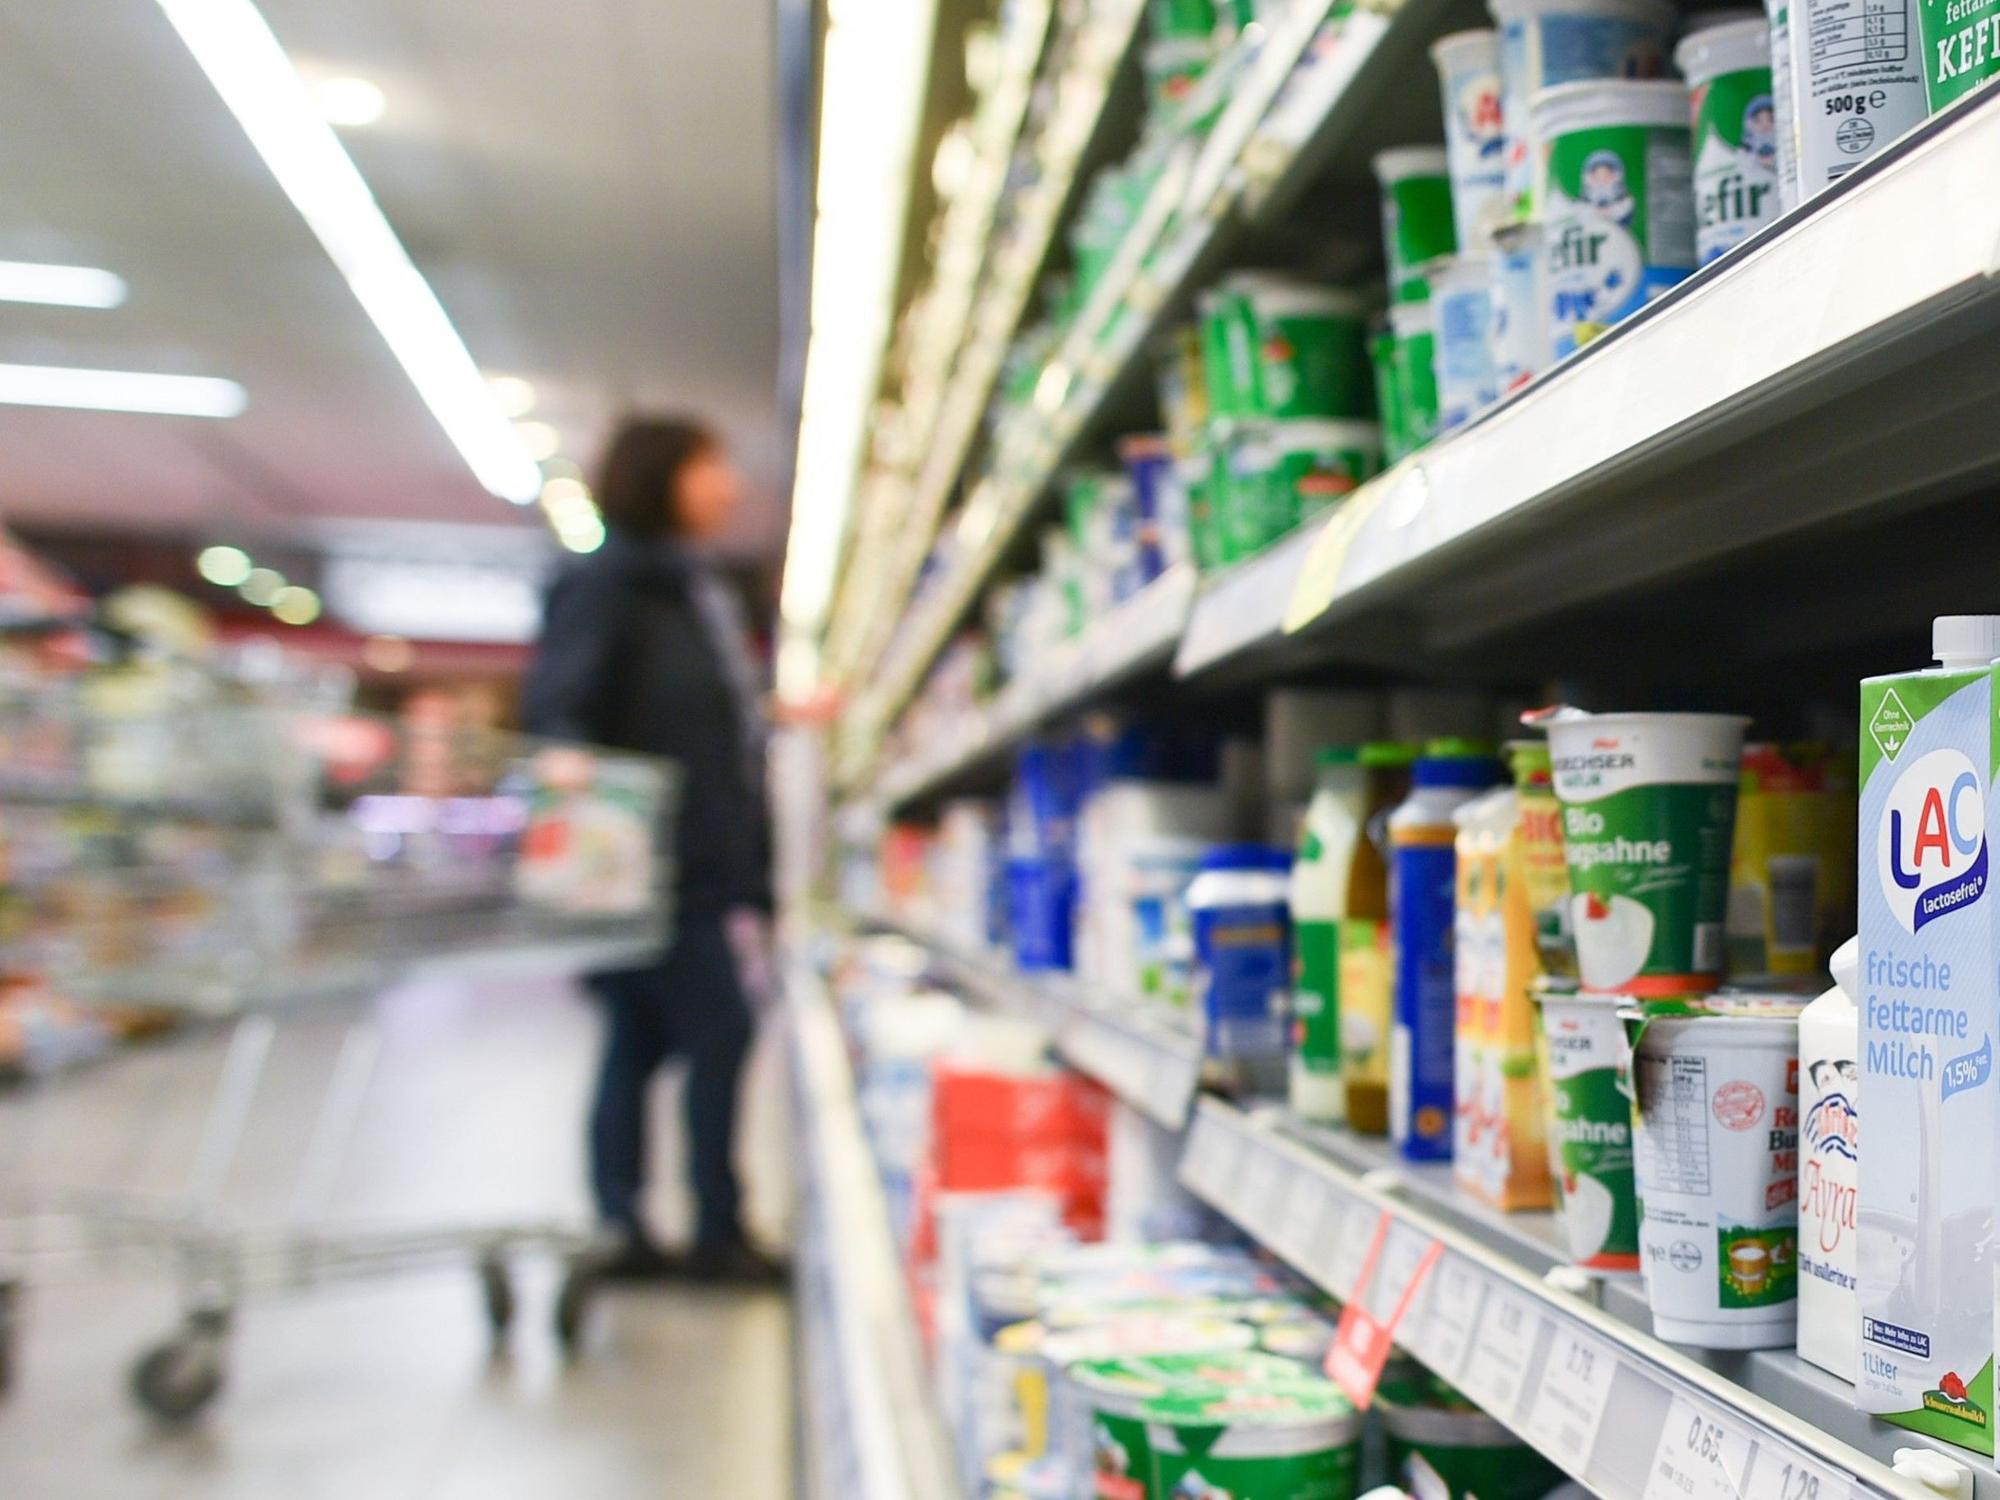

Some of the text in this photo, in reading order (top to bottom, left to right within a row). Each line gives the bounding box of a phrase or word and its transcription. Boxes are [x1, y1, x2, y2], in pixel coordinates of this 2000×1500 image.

[1945, 0, 1997, 25] fettar
[1891, 772, 1977, 889] LAC
[1867, 950, 1951, 991] frische
[1867, 995, 1968, 1039] fettarme
[1867, 1041, 1933, 1081] Milch
[1945, 1061, 1978, 1088] 1,5%
[1869, 1353, 1898, 1381] Liter
[1687, 1415, 1724, 1465] 0.65
